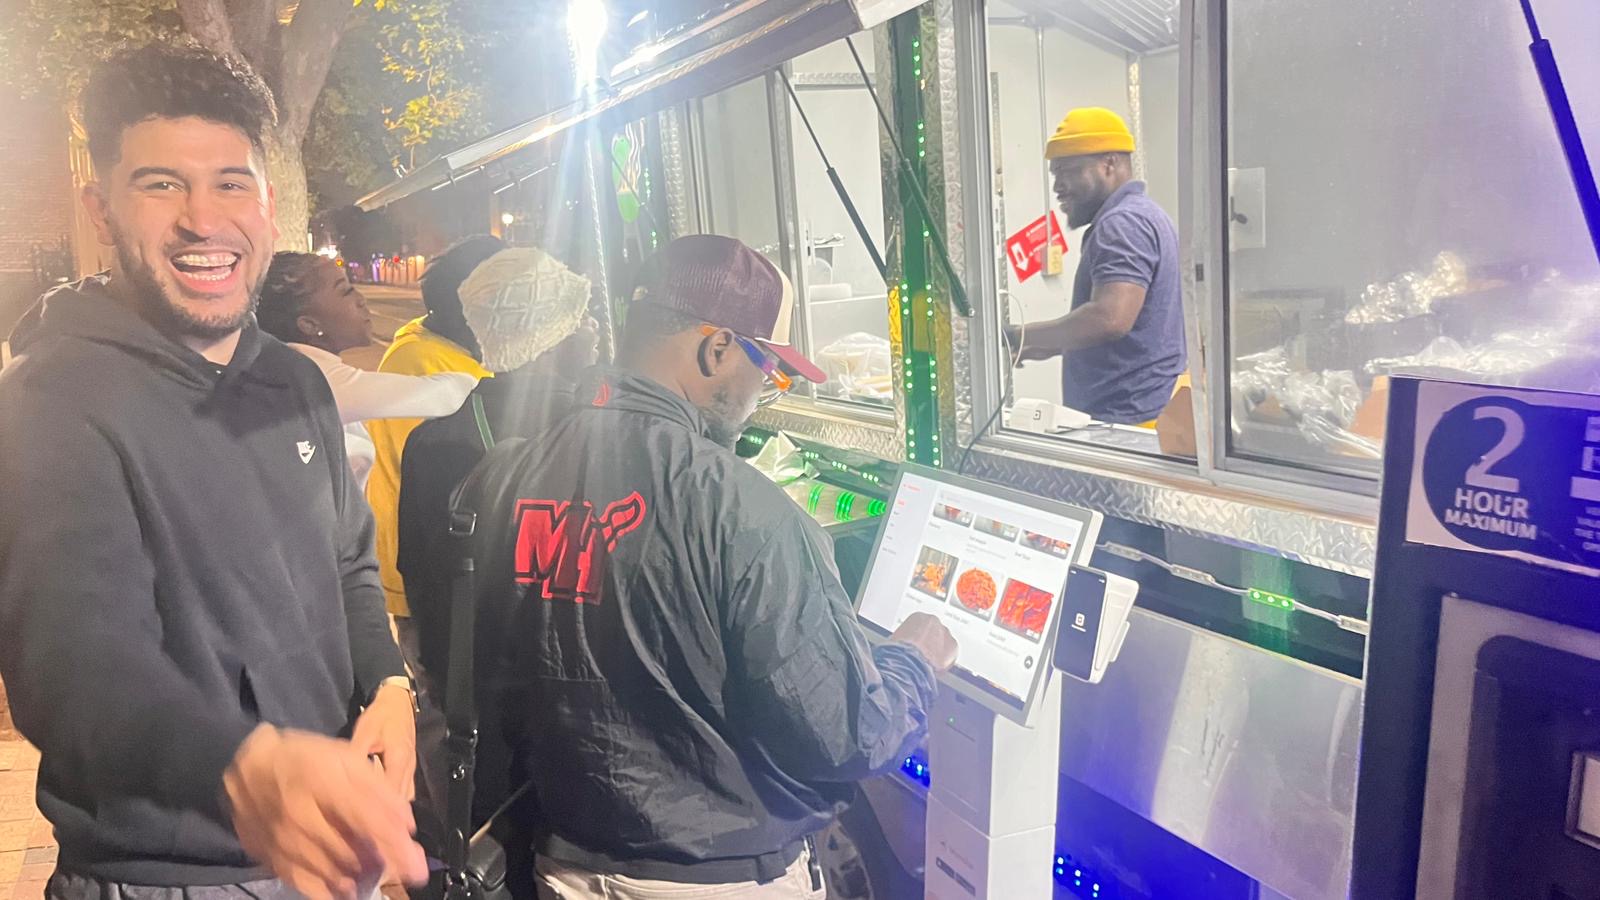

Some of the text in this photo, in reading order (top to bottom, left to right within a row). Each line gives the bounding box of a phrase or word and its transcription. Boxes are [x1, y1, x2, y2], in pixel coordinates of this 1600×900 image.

[1465, 406, 1525, 493] 2
[1455, 488, 1529, 519] HOUR
[1445, 509, 1537, 540] MAXIMUM
